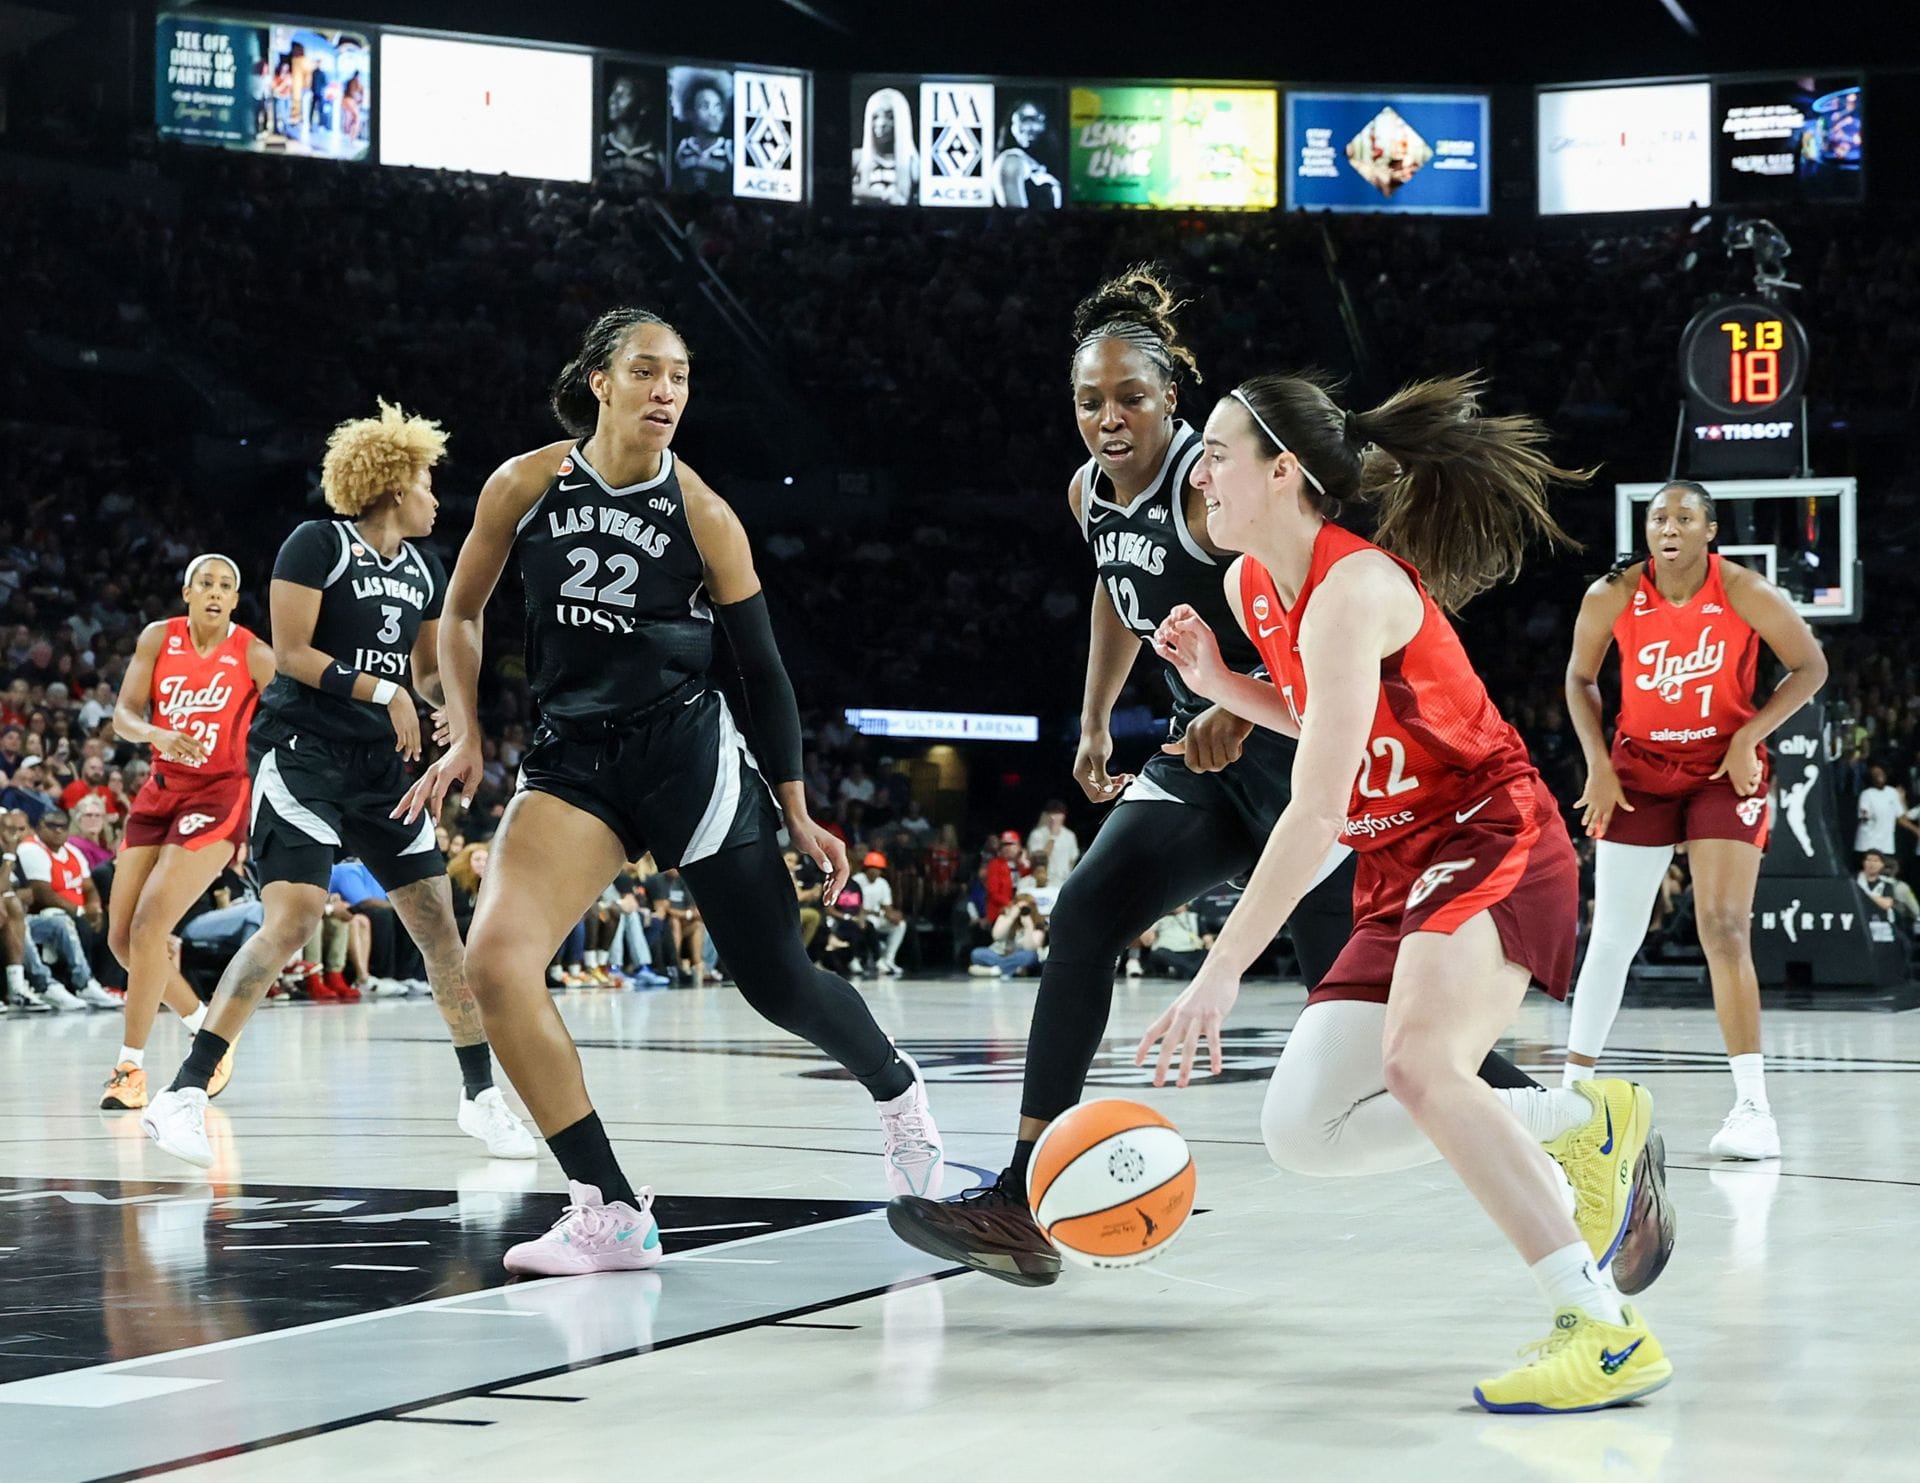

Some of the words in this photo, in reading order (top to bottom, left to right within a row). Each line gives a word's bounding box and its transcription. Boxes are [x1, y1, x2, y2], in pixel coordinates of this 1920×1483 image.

[744, 178, 792, 193] ACES
[932, 189, 983, 200] ACES
[1720, 321, 1784, 351] 7:13
[1730, 351, 1778, 404] 18
[648, 497, 677, 517] ally
[1148, 505, 1168, 524] ally
[549, 505, 595, 538] LAS
[598, 506, 671, 558] VEGAS
[1094, 531, 1117, 569] LAS
[1117, 531, 1167, 576] VEGAS
[351, 576, 384, 600] LAS
[381, 576, 424, 610] VEGAS
[560, 547, 640, 608] 22
[1107, 575, 1157, 630] 12
[376, 604, 402, 644] 3
[354, 648, 409, 676] IPSY
[1635, 625, 1726, 690] Indy
[158, 671, 233, 716] Indy
[1694, 684, 1713, 718] 1
[190, 720, 220, 756] 25
[974, 721, 1025, 733] ARENA
[1650, 725, 1717, 744] salesforce
[1778, 735, 1818, 759] ally
